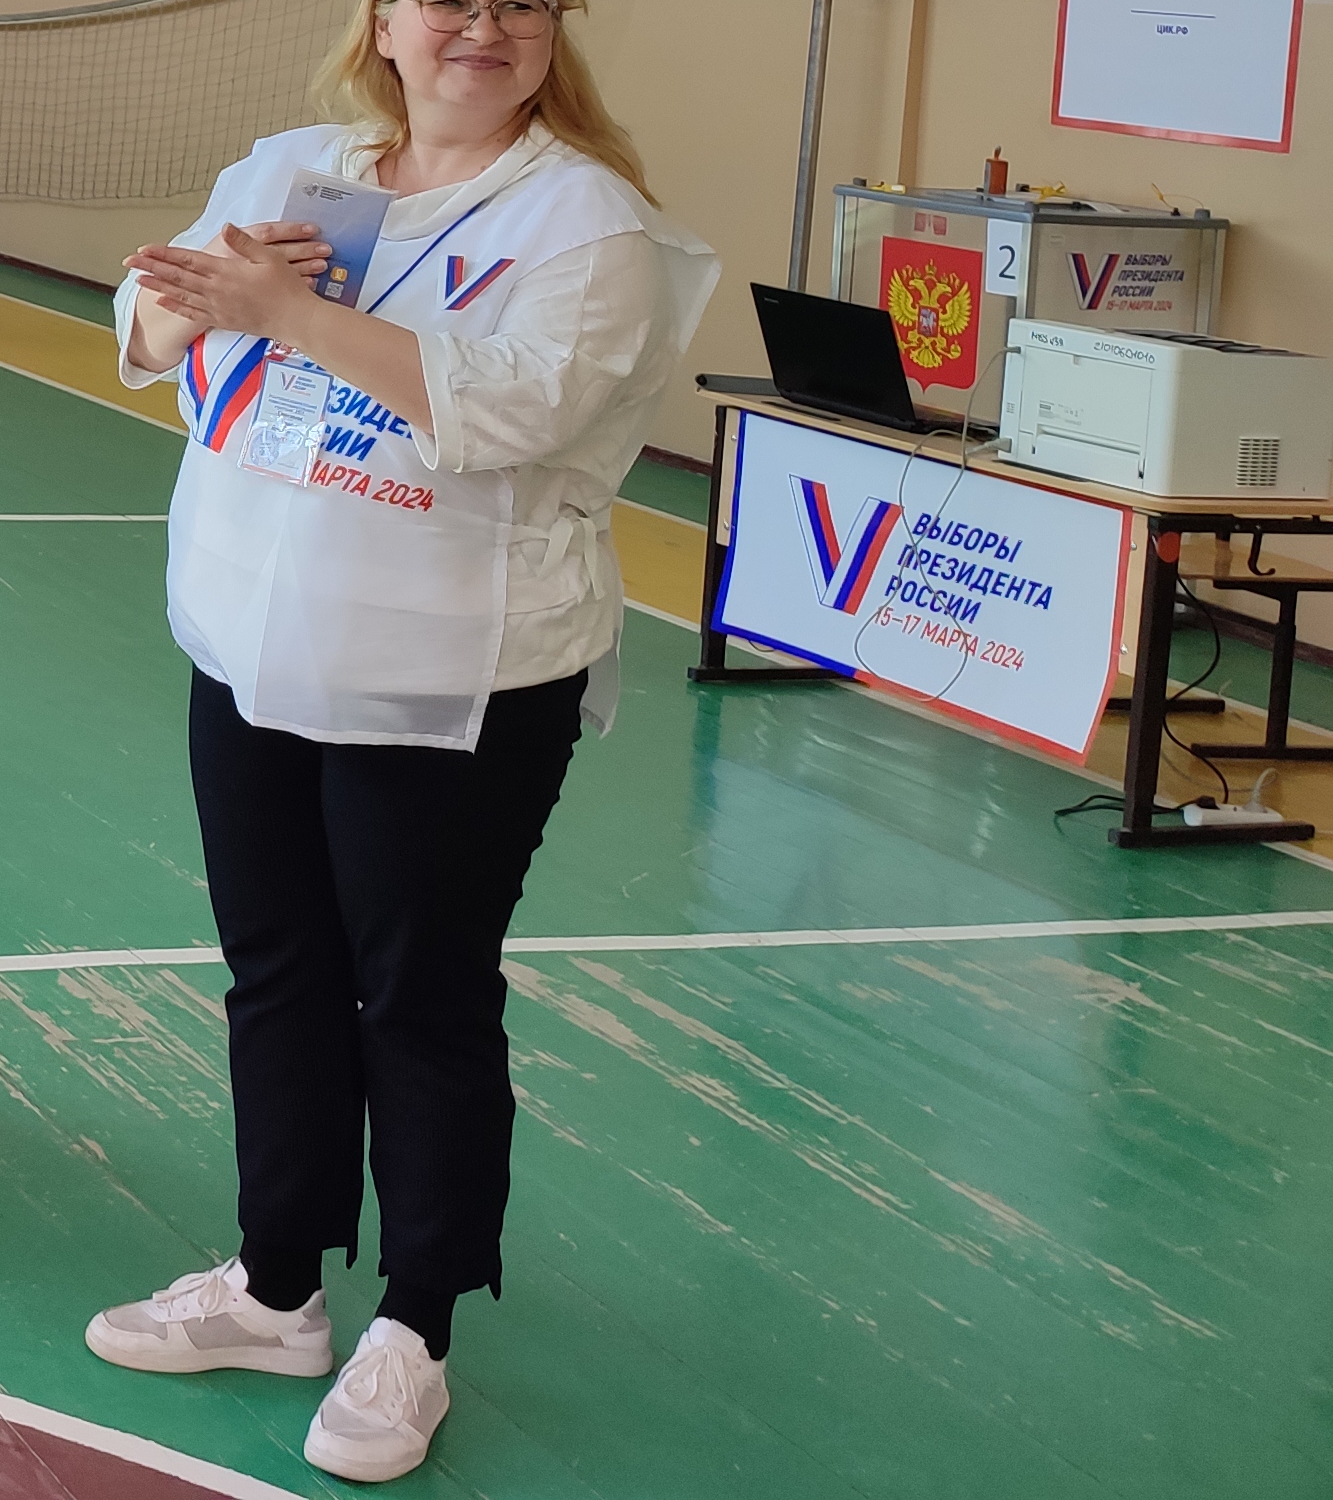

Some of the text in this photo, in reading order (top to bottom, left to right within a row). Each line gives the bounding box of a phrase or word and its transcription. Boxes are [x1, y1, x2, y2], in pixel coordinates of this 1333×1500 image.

[1156, 23, 1189, 35] ЦИК.РФ
[998, 244, 1016, 280] 2
[1117, 269, 1184, 282] ПРЕЗИДЕНТА
[1124, 254, 1172, 266] ВЫБОРЫ
[1111, 285, 1155, 297] РОССИИ
[371, 479, 434, 513] 2024
[912, 512, 1023, 564] ВЫБОРЫ
[897, 544, 1053, 611] ПРЕЗИДЕНТА
[884, 575, 982, 625] РОССИИ
[921, 620, 980, 658] МАРТА
[979, 640, 1025, 672] 2024
